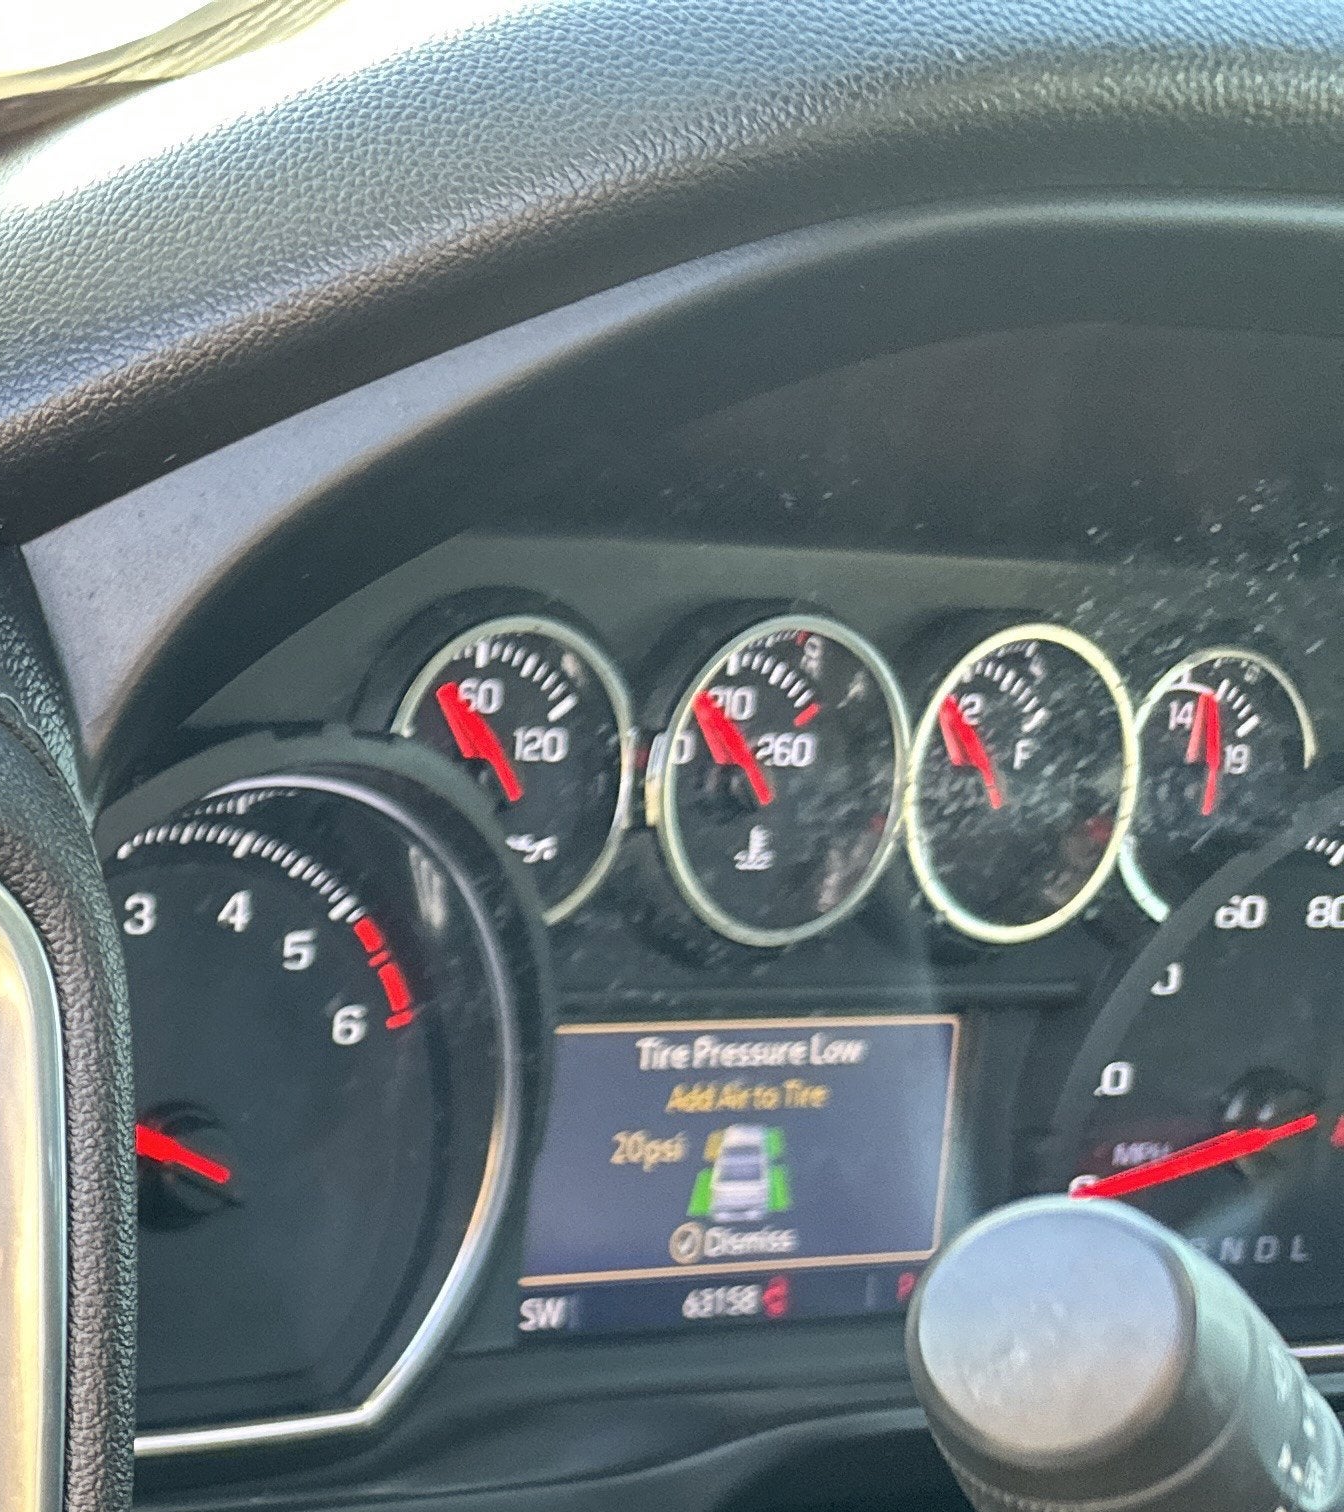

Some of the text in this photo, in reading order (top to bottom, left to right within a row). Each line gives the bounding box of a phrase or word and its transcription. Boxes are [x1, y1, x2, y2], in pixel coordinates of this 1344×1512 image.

[1168, 700, 1195, 731] 14
[513, 726, 569, 762] 120
[755, 733, 816, 767] 260
[1013, 738, 1037, 770] F
[1224, 743, 1251, 775] 19
[122, 892, 156, 935] 3
[217, 889, 253, 932] 4
[1214, 894, 1267, 929] 60
[282, 929, 316, 971] 5
[331, 1004, 367, 1046] 6
[635, 1032, 867, 1071] Tire Pressure Low
[666, 1078, 831, 1113] Add Air to Tire
[610, 1129, 687, 1173] 20psi
[704, 1226, 798, 1257] Dismiss
[518, 1296, 568, 1332] SW
